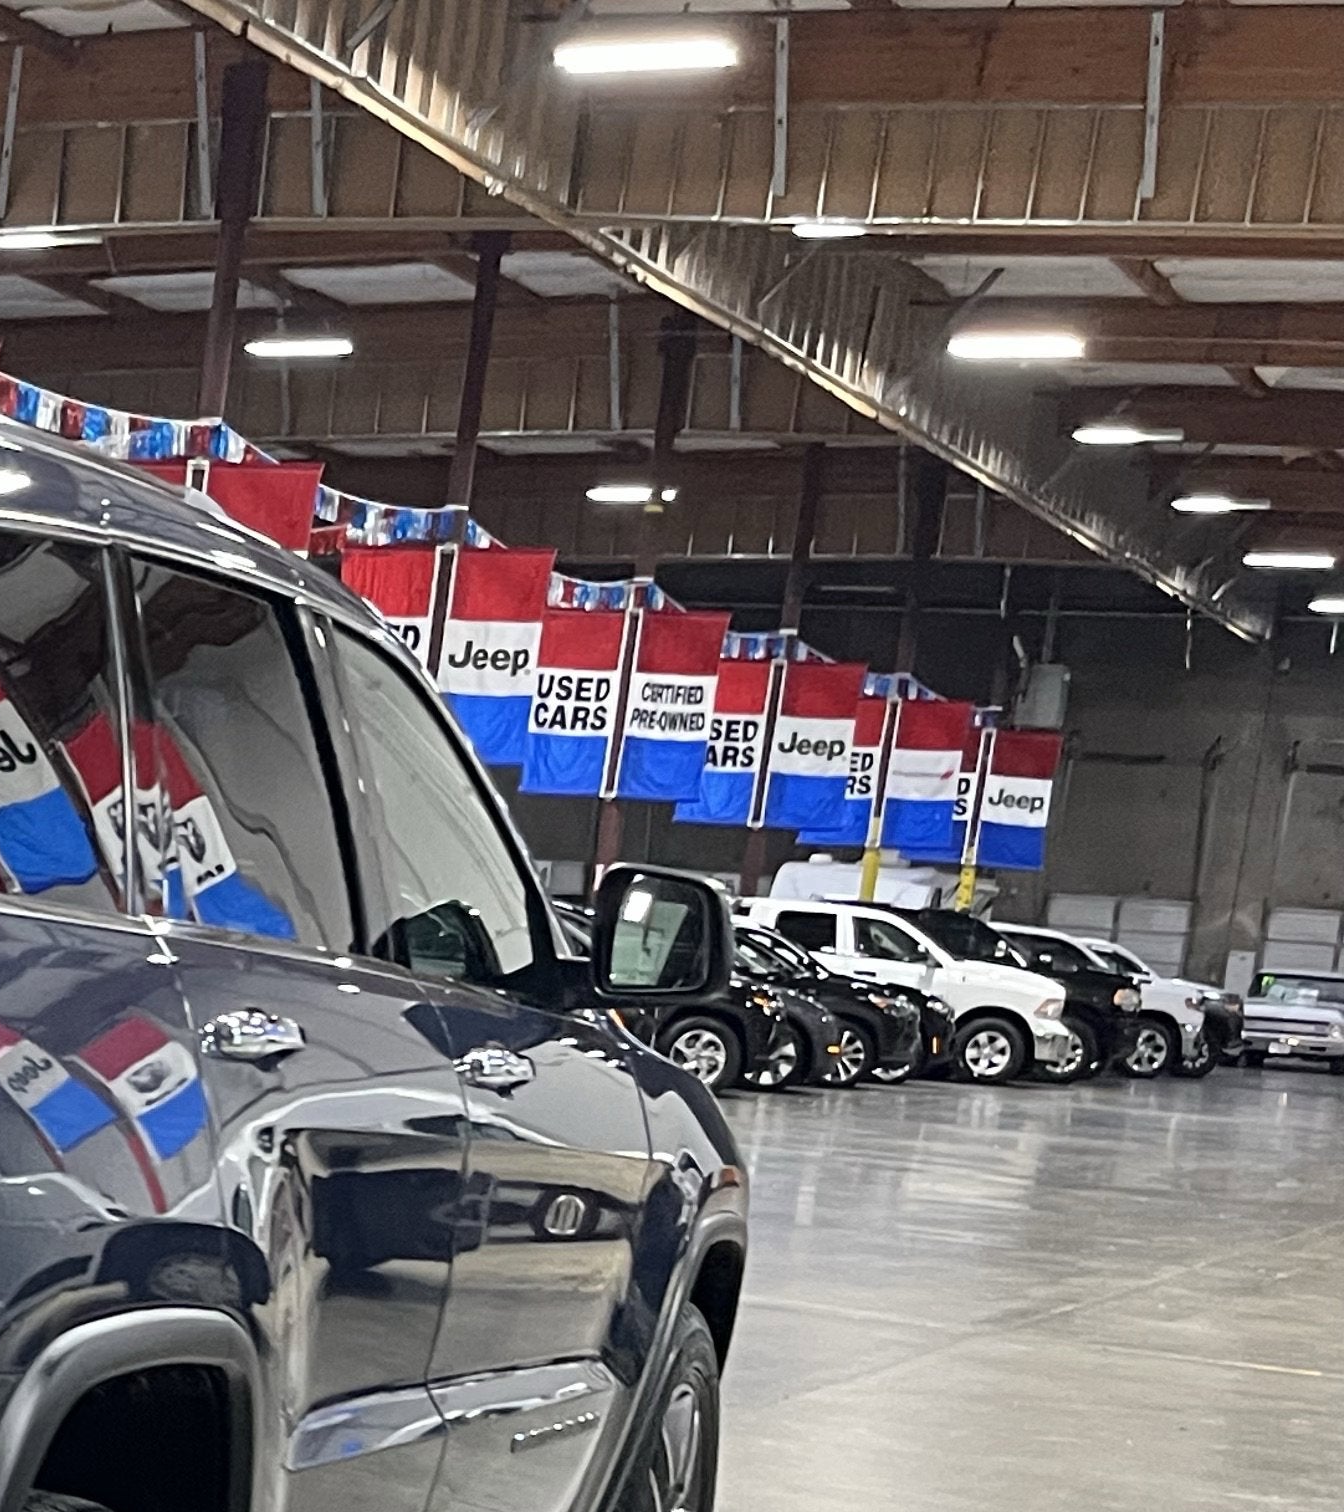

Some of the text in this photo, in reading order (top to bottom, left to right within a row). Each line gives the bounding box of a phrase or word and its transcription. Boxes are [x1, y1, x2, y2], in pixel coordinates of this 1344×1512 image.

[448, 640, 530, 677] Jeep
[537, 674, 610, 701] USED
[641, 682, 704, 705] CERTIFIED
[534, 702, 608, 731] CARS
[629, 708, 705, 732] PRE-OWNED
[709, 718, 759, 743] SED
[704, 744, 754, 768] ARS
[778, 731, 846, 761] Jeep
[988, 788, 1045, 814] Jeep
